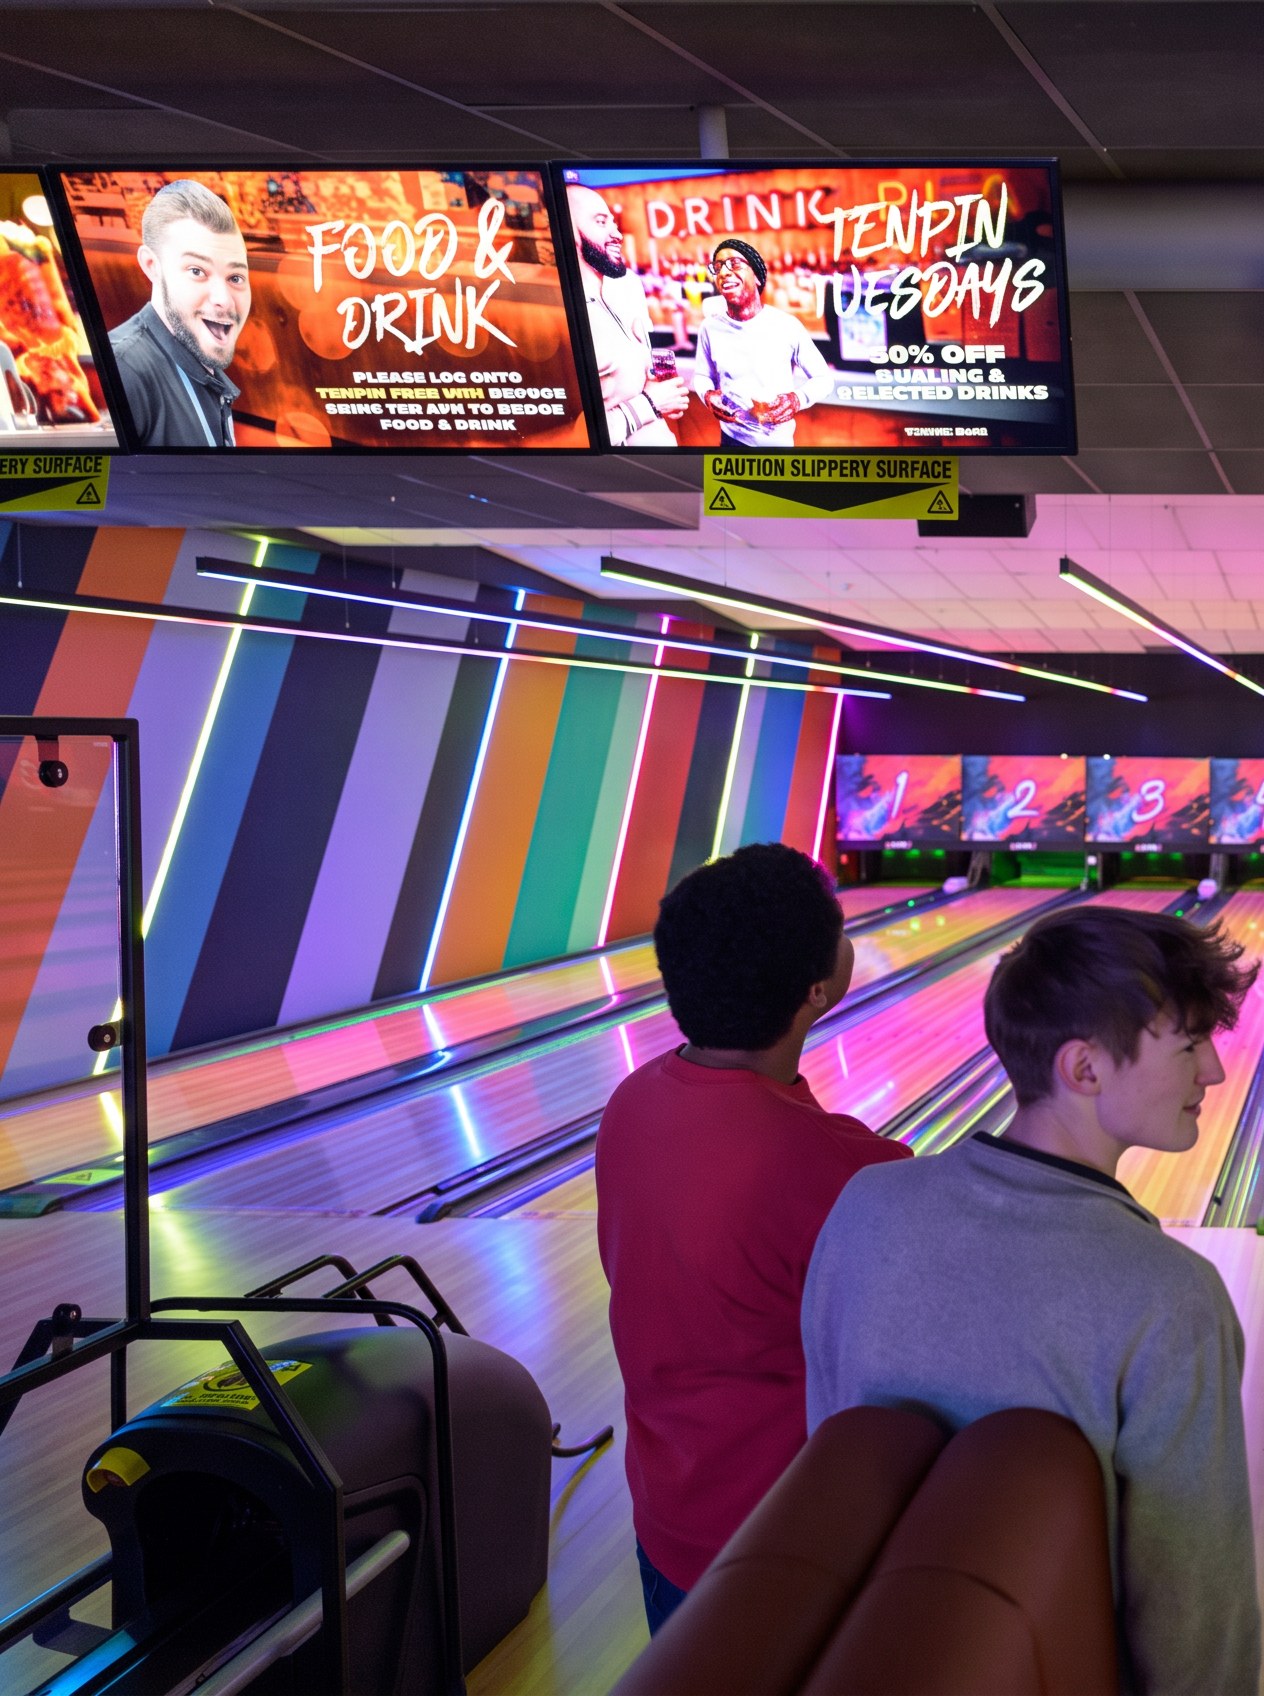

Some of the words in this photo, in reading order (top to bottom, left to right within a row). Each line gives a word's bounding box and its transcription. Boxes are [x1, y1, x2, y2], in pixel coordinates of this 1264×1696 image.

[826, 182, 1007, 262] TENPIN
[305, 213, 457, 292] FOOD
[474, 197, 516, 284] &
[813, 257, 1046, 328] TUESDAYS
[336, 277, 517, 355] DRINK
[870, 344, 935, 364] 50%
[941, 344, 1006, 364] OFF
[353, 371, 427, 384] PLEASE
[470, 371, 523, 384] ONTO
[988, 368, 1006, 383] &
[315, 387, 387, 399] TENPIN
[390, 387, 440, 399] FREE
[958, 385, 1049, 400] DRINKS
[386, 403, 424, 415] TER
[468, 403, 494, 415] TO
[380, 419, 434, 431] FOOD
[438, 419, 452, 431] &
[454, 419, 517, 431] DRINK
[33, 456, 102, 474] SURFACE
[712, 457, 785, 477] CAUTION
[790, 458, 871, 478] SLIPPERY
[876, 460, 952, 479] SURFACE
[891, 771, 908, 819] 1
[1007, 780, 1039, 818] 2
[1131, 779, 1165, 823] 3
